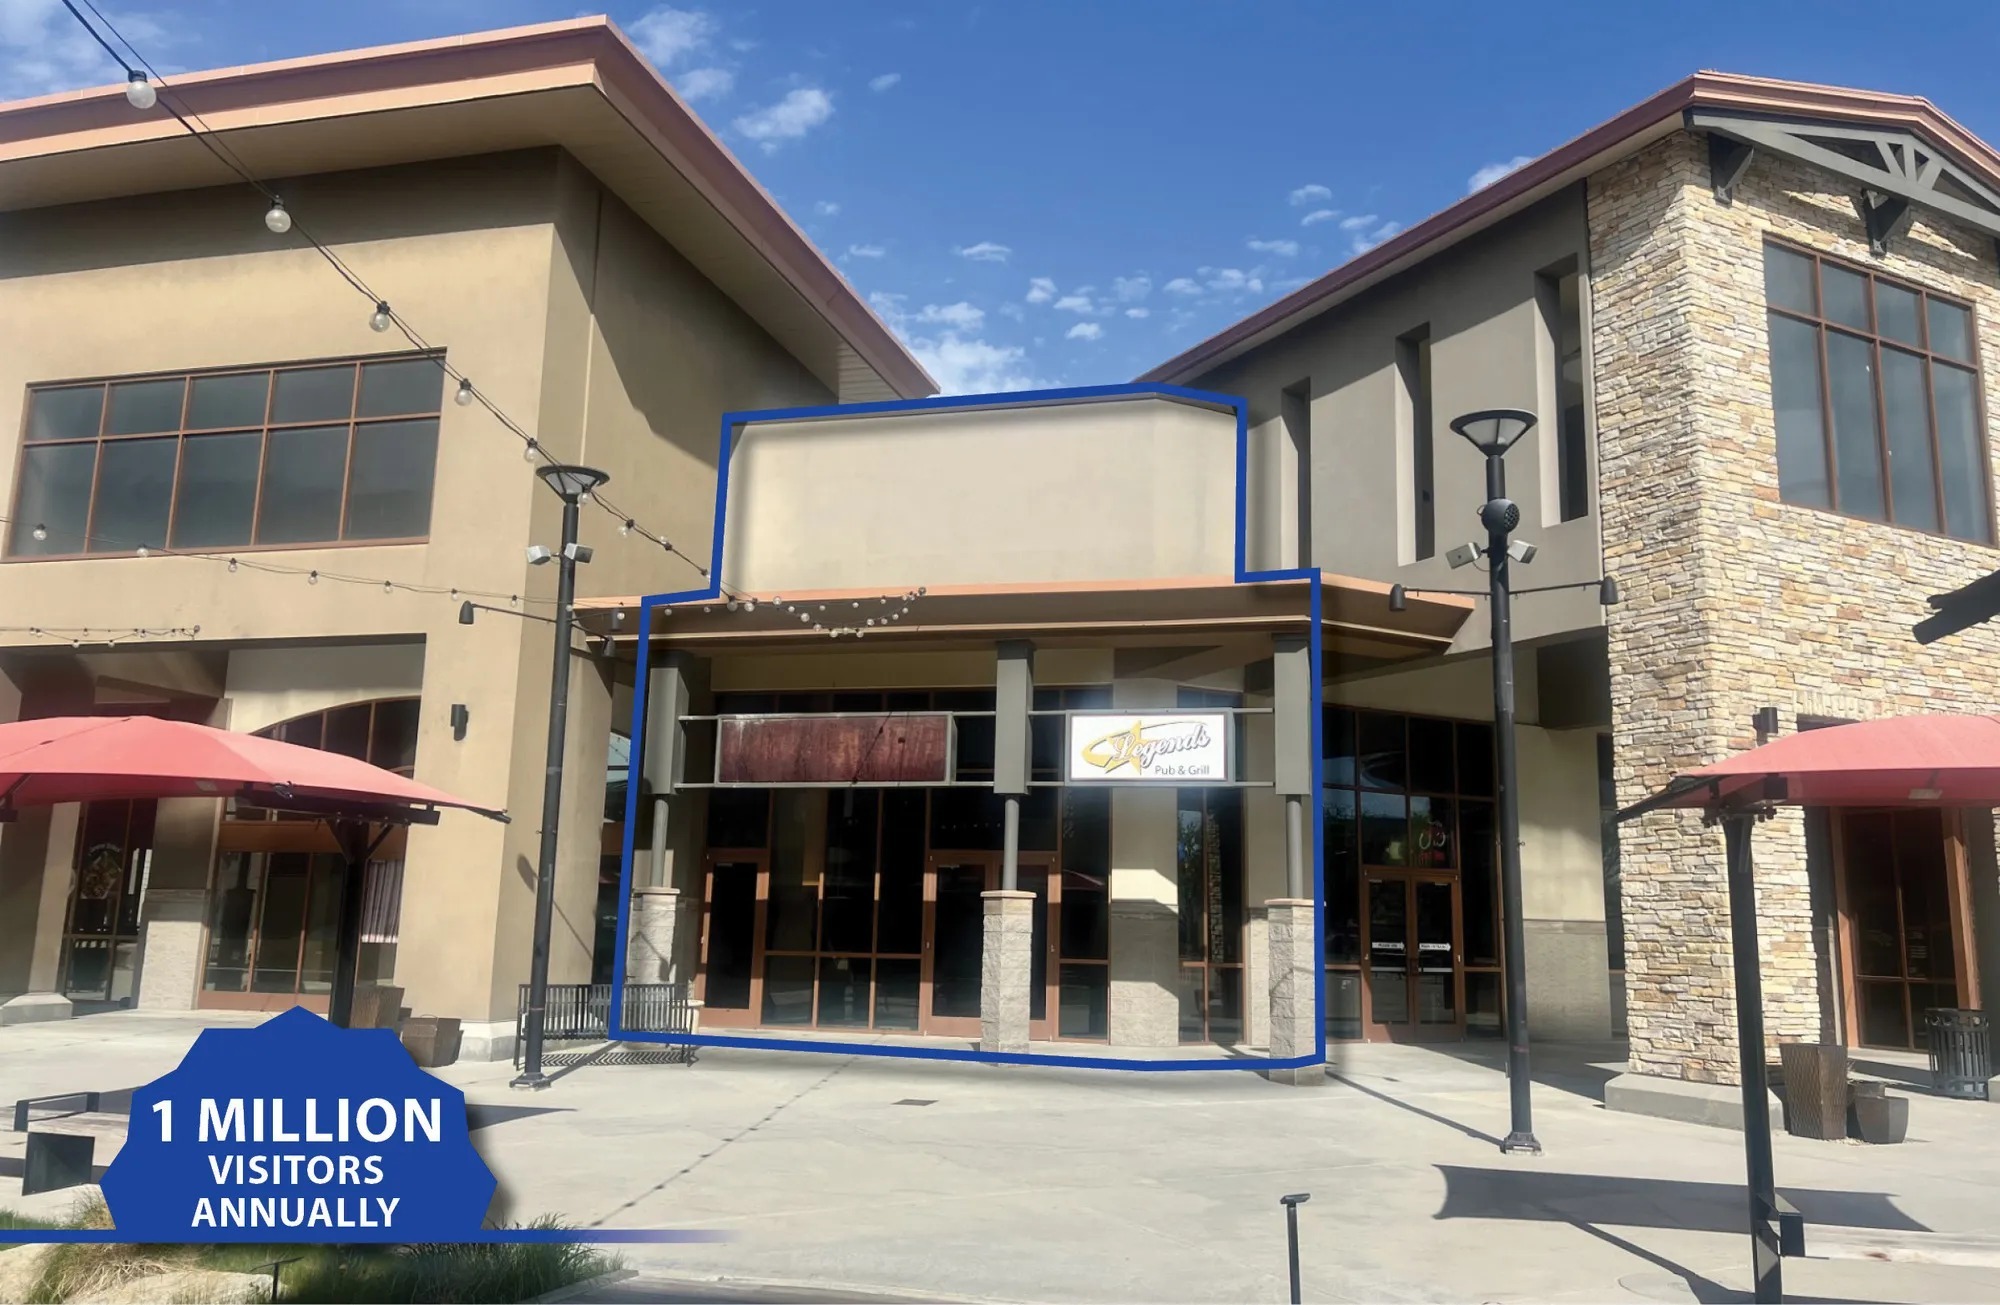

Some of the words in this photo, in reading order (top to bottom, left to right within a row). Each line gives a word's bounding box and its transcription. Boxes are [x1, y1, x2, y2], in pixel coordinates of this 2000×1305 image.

[1112, 722, 1211, 769] Legends
[1154, 764, 1176, 775] Pub
[1177, 764, 1186, 775] &
[1188, 764, 1210, 775] Grill
